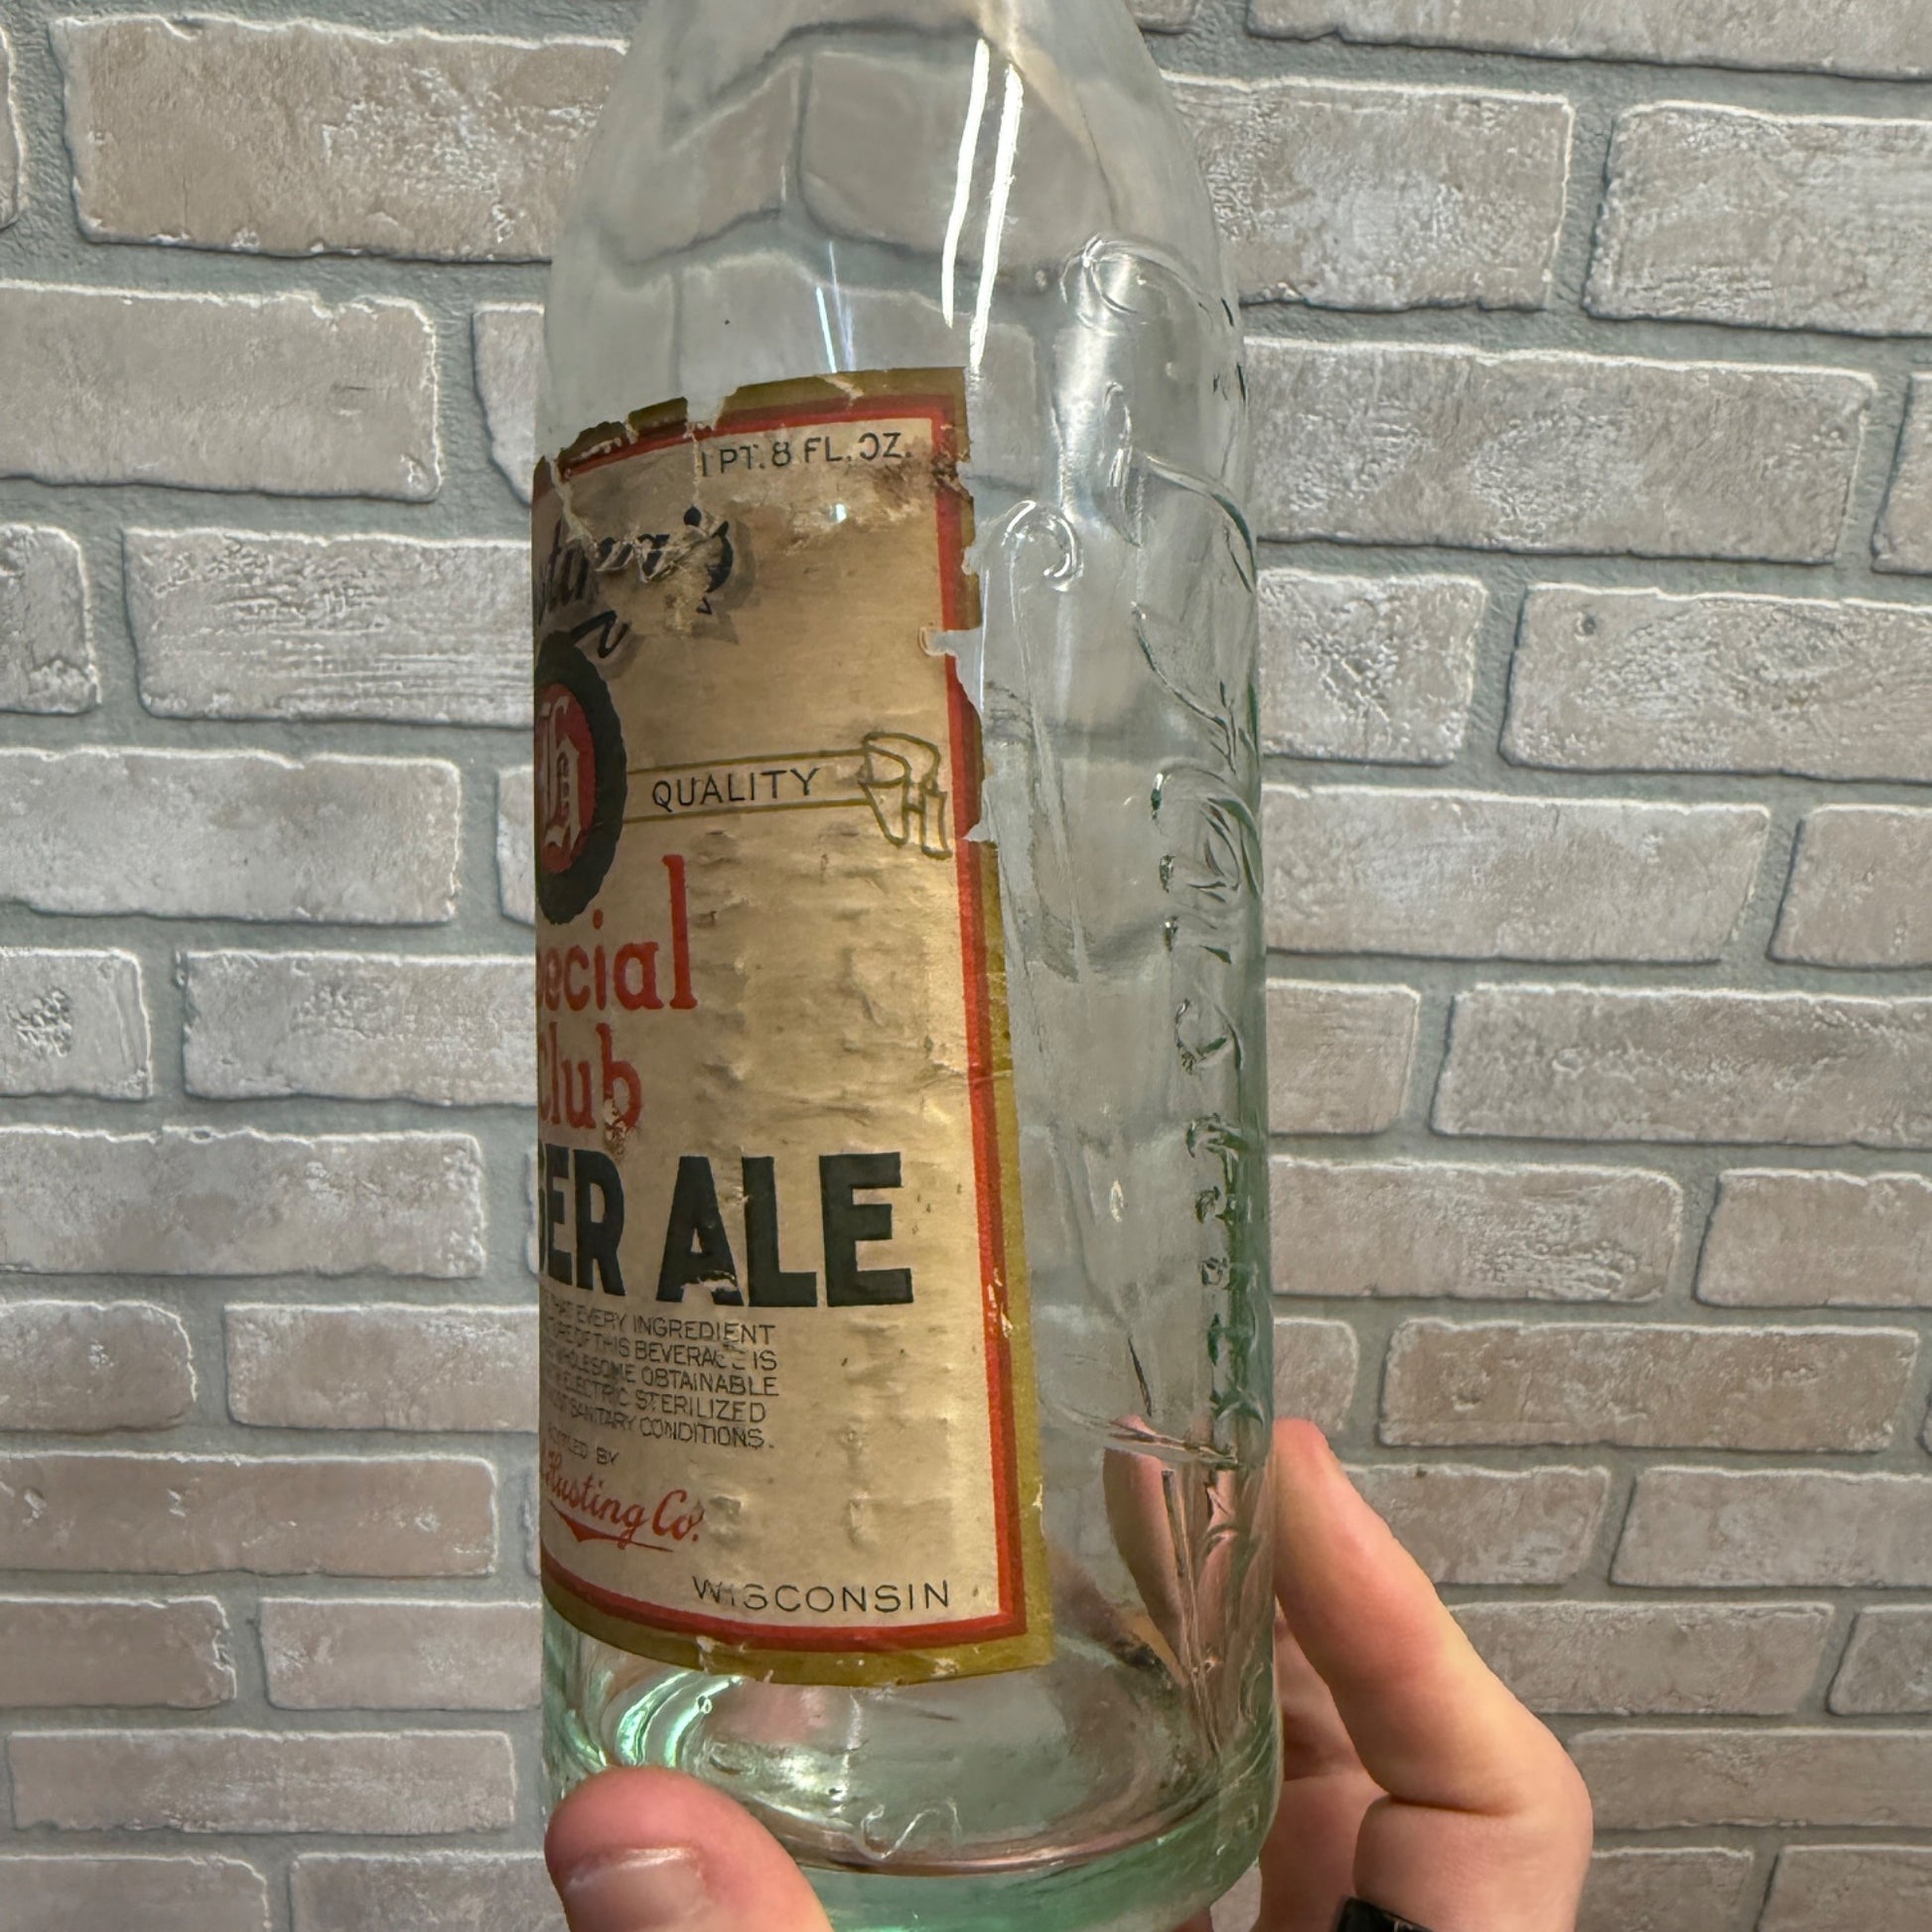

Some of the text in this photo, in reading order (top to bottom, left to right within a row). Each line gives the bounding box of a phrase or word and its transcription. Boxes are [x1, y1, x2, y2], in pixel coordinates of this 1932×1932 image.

[720, 443, 765, 476] PT.
[771, 441, 792, 467] 8
[804, 435, 852, 464] FL.
[651, 766, 820, 813] QUALITY
[539, 1142, 915, 1309] ER ALE
[633, 1314, 776, 1345] INGREDIENT
[753, 1349, 777, 1371] IS
[641, 1365, 780, 1397] OBTAINABLE
[635, 1389, 767, 1424] STERILIZED
[639, 1415, 775, 1449] CONDITIONS.
[597, 1446, 620, 1465] BY
[691, 1575, 949, 1613] WISCONSIN
